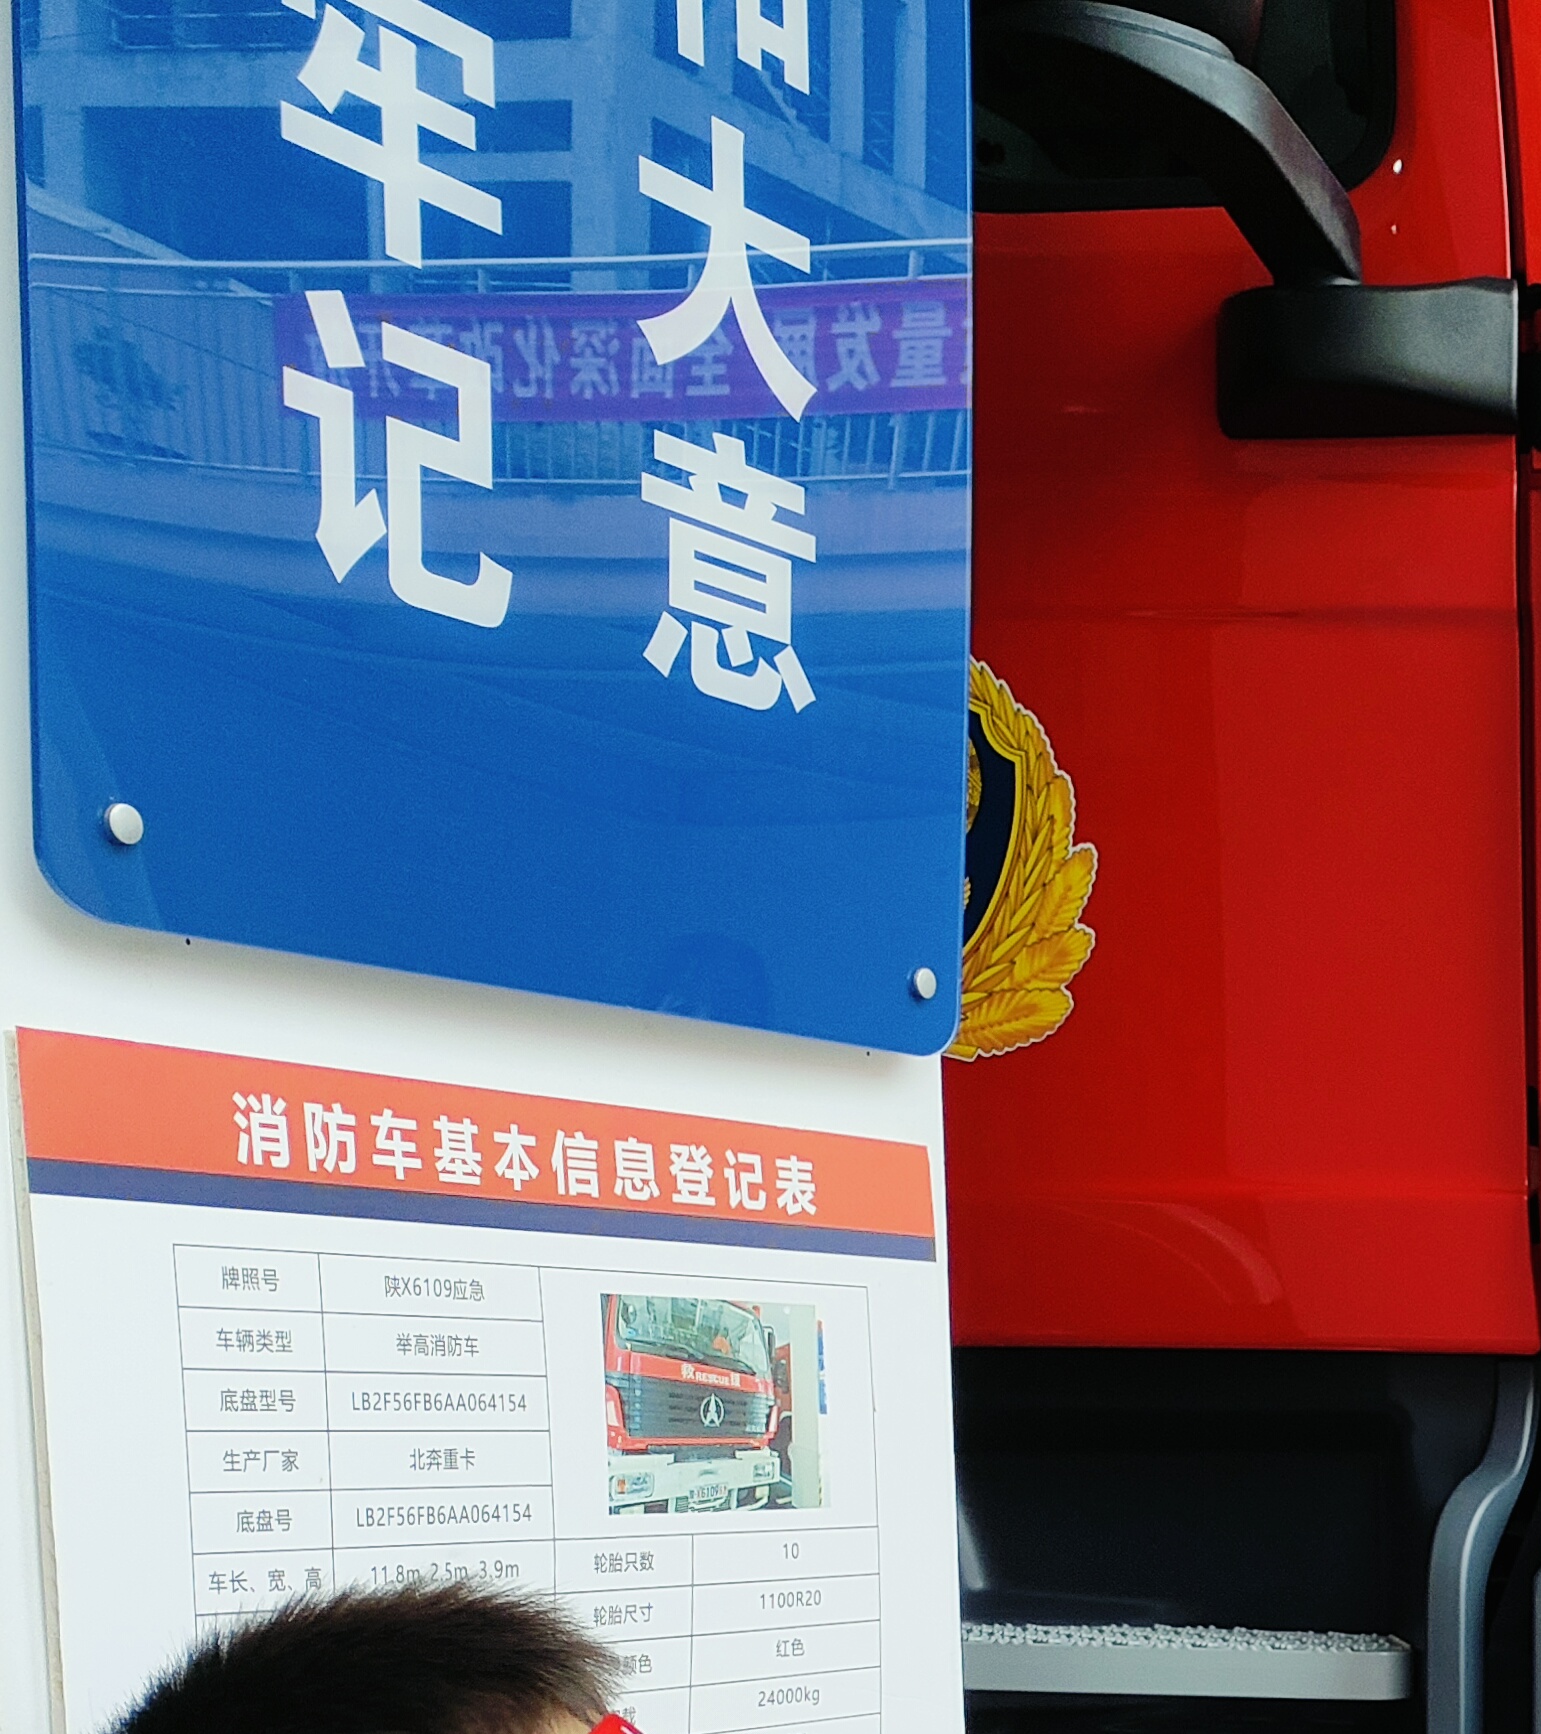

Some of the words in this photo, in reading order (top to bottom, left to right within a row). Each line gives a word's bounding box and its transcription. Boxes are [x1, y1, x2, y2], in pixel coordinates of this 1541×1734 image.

[280, 0, 514, 628] 牢记
[231, 1091, 818, 1217] 消防车基本信息登记表
[221, 1266, 280, 1292] 牌照号
[384, 1275, 486, 1302] 陕X6109应急
[215, 1328, 293, 1355] 车辆类型
[396, 1333, 480, 1358] 举高消防车
[219, 1389, 296, 1414] 底盘型号
[351, 1391, 527, 1413] LB2F56FB6AA064154
[222, 1449, 300, 1473] 生产厂家
[409, 1448, 476, 1472] 北奔重卡
[236, 1509, 293, 1534] 底盘号
[356, 1503, 533, 1528] LB2F56FB6AA064154
[593, 1551, 655, 1574] 轮胎只数
[782, 1542, 800, 1559] 10
[759, 1589, 822, 1610] 1100R20
[593, 1602, 654, 1626] 轮胎尺寸
[775, 1638, 805, 1658] 红色
[757, 1686, 820, 1708] 24000kg
